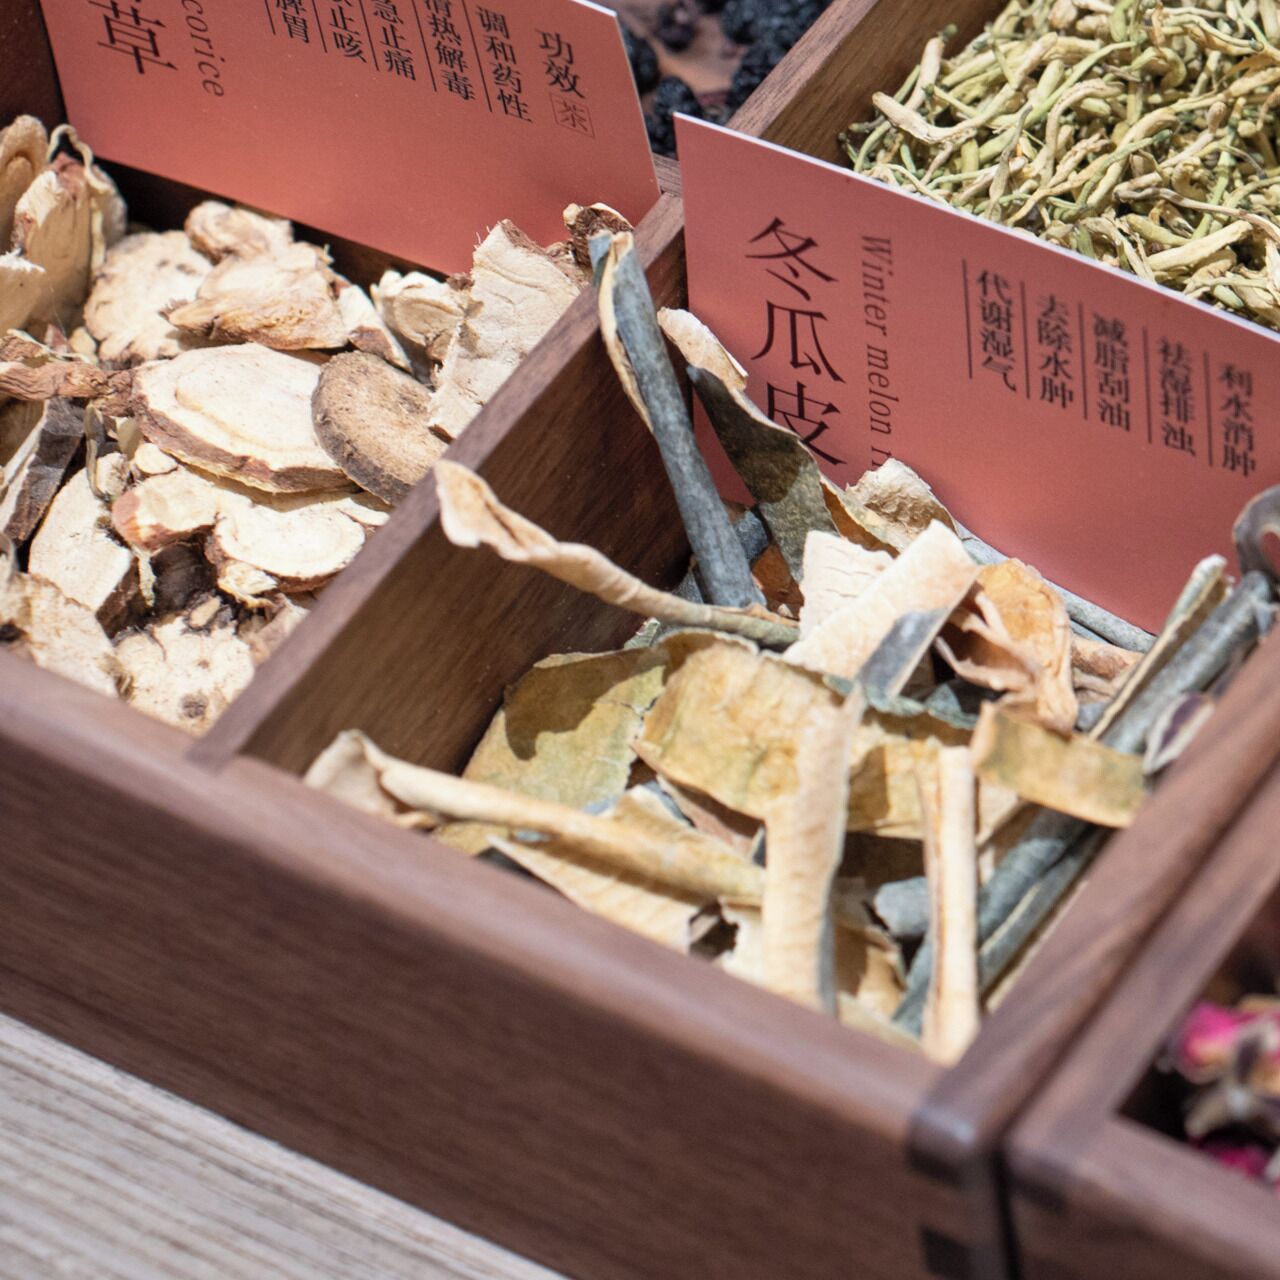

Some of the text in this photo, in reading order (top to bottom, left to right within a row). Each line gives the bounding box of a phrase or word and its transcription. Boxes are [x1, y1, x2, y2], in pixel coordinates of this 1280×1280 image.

[475, 4, 533, 123] 调和药性
[537, 28, 588, 100] 功效
[744, 217, 847, 466] 冬瓜皮
[861, 234, 895, 337] Winter
[975, 268, 1017, 393] 代谢湿气
[867, 343, 900, 437] melon
[1037, 293, 1074, 411] 去除水肿
[1093, 311, 1132, 434] 减脂刮油
[1156, 335, 1197, 458] 祛湿排浊
[1220, 361, 1257, 480] 利水消肿
